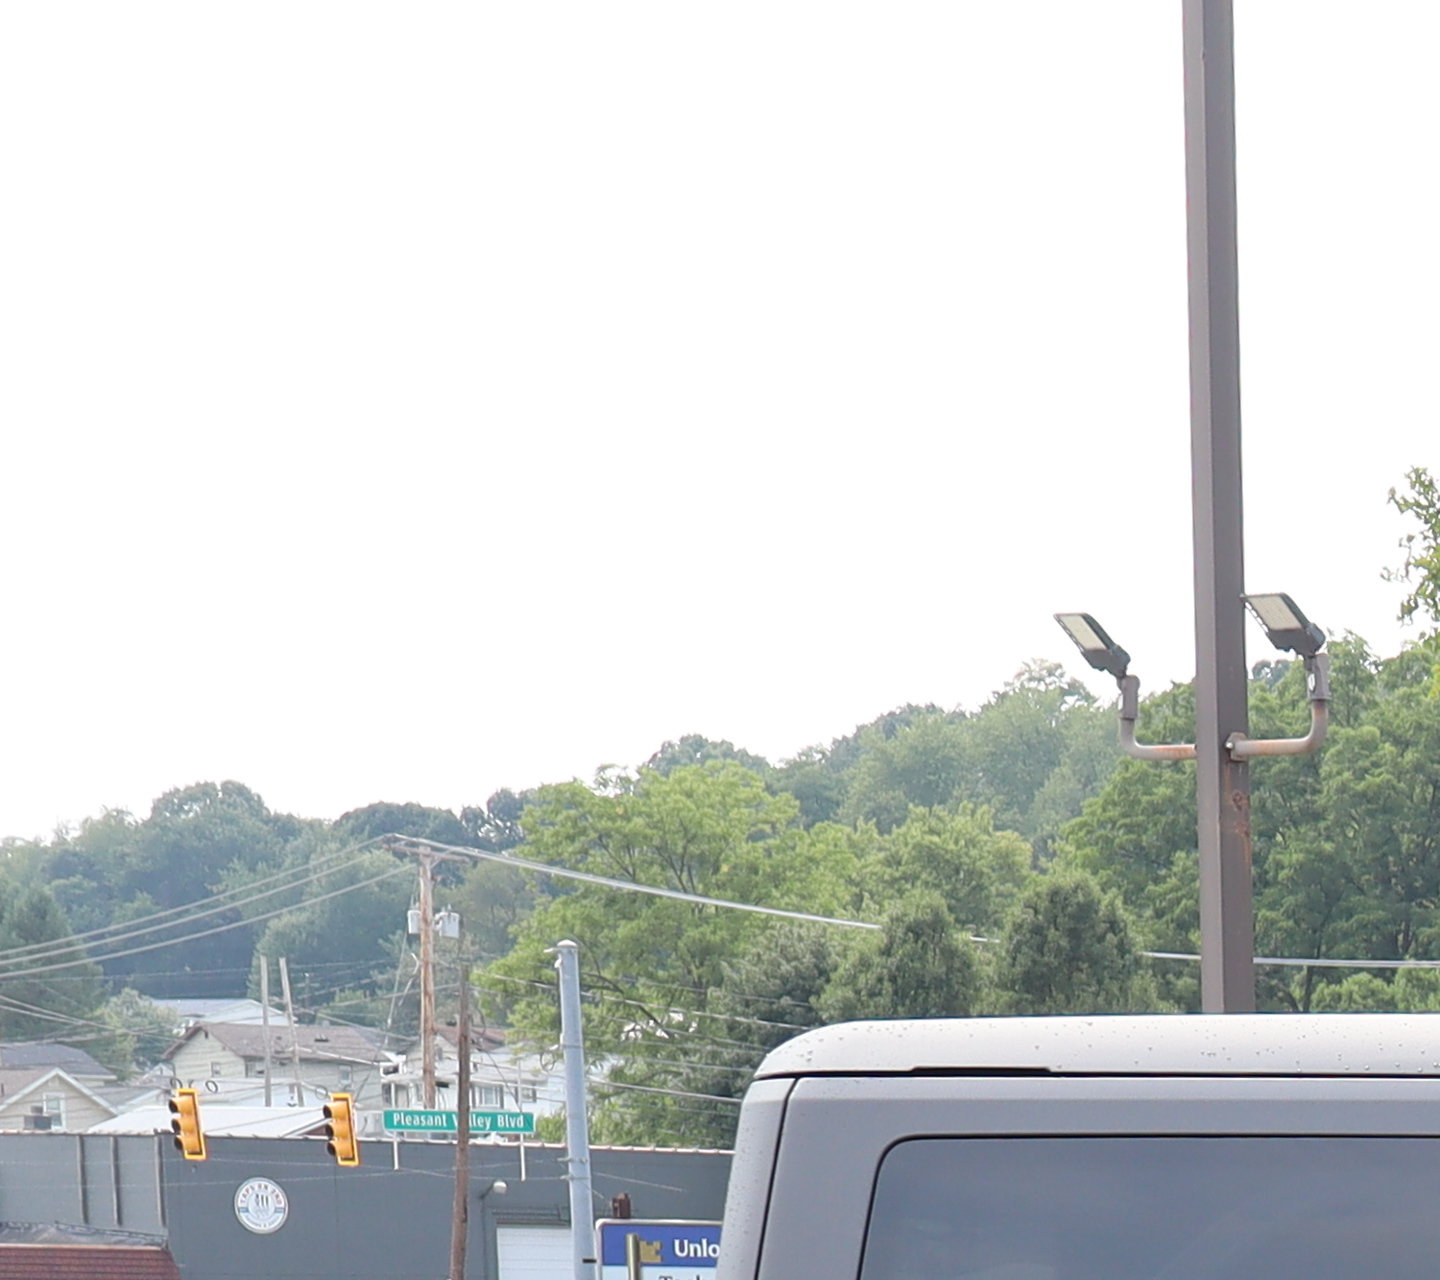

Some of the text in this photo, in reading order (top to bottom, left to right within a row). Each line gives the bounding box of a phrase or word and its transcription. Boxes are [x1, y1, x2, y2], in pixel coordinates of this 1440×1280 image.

[393, 1112, 524, 1131] Pleasant Vlley Blvd
